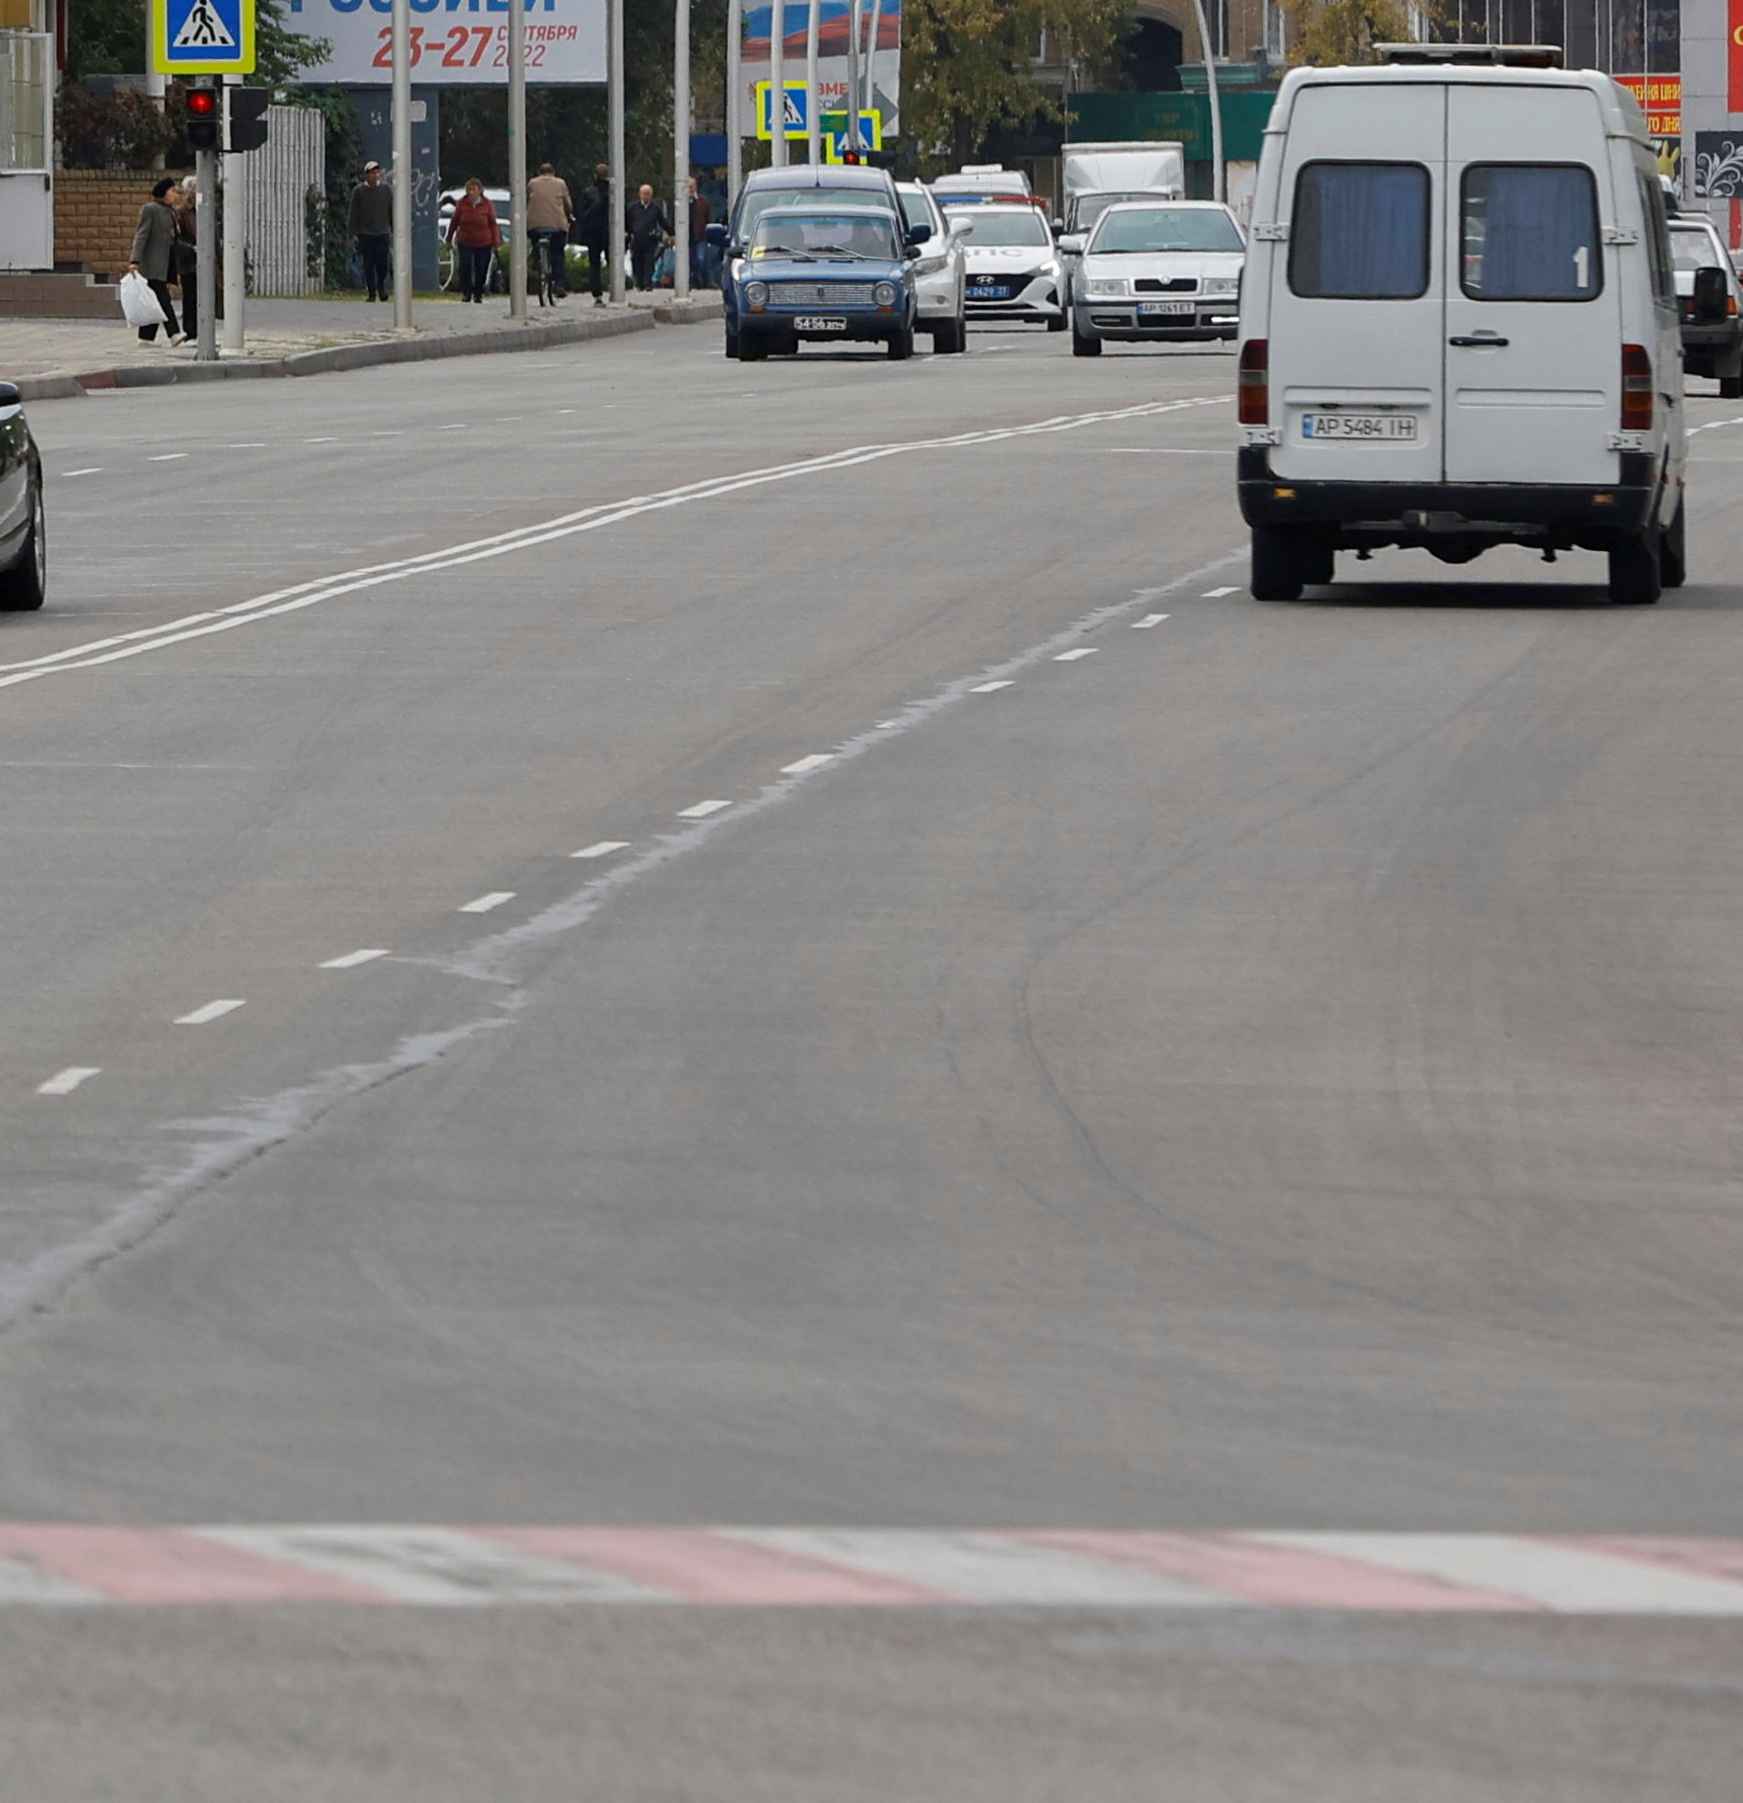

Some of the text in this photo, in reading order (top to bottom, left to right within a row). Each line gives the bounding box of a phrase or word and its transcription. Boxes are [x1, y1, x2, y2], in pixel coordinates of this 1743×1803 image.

[497, 24, 578, 42] СТЯБРЯ
[493, 45, 545, 68] 222
[1573, 246, 1588, 288] 1
[1315, 417, 1339, 435] AP
[1342, 418, 1383, 436] 5484
